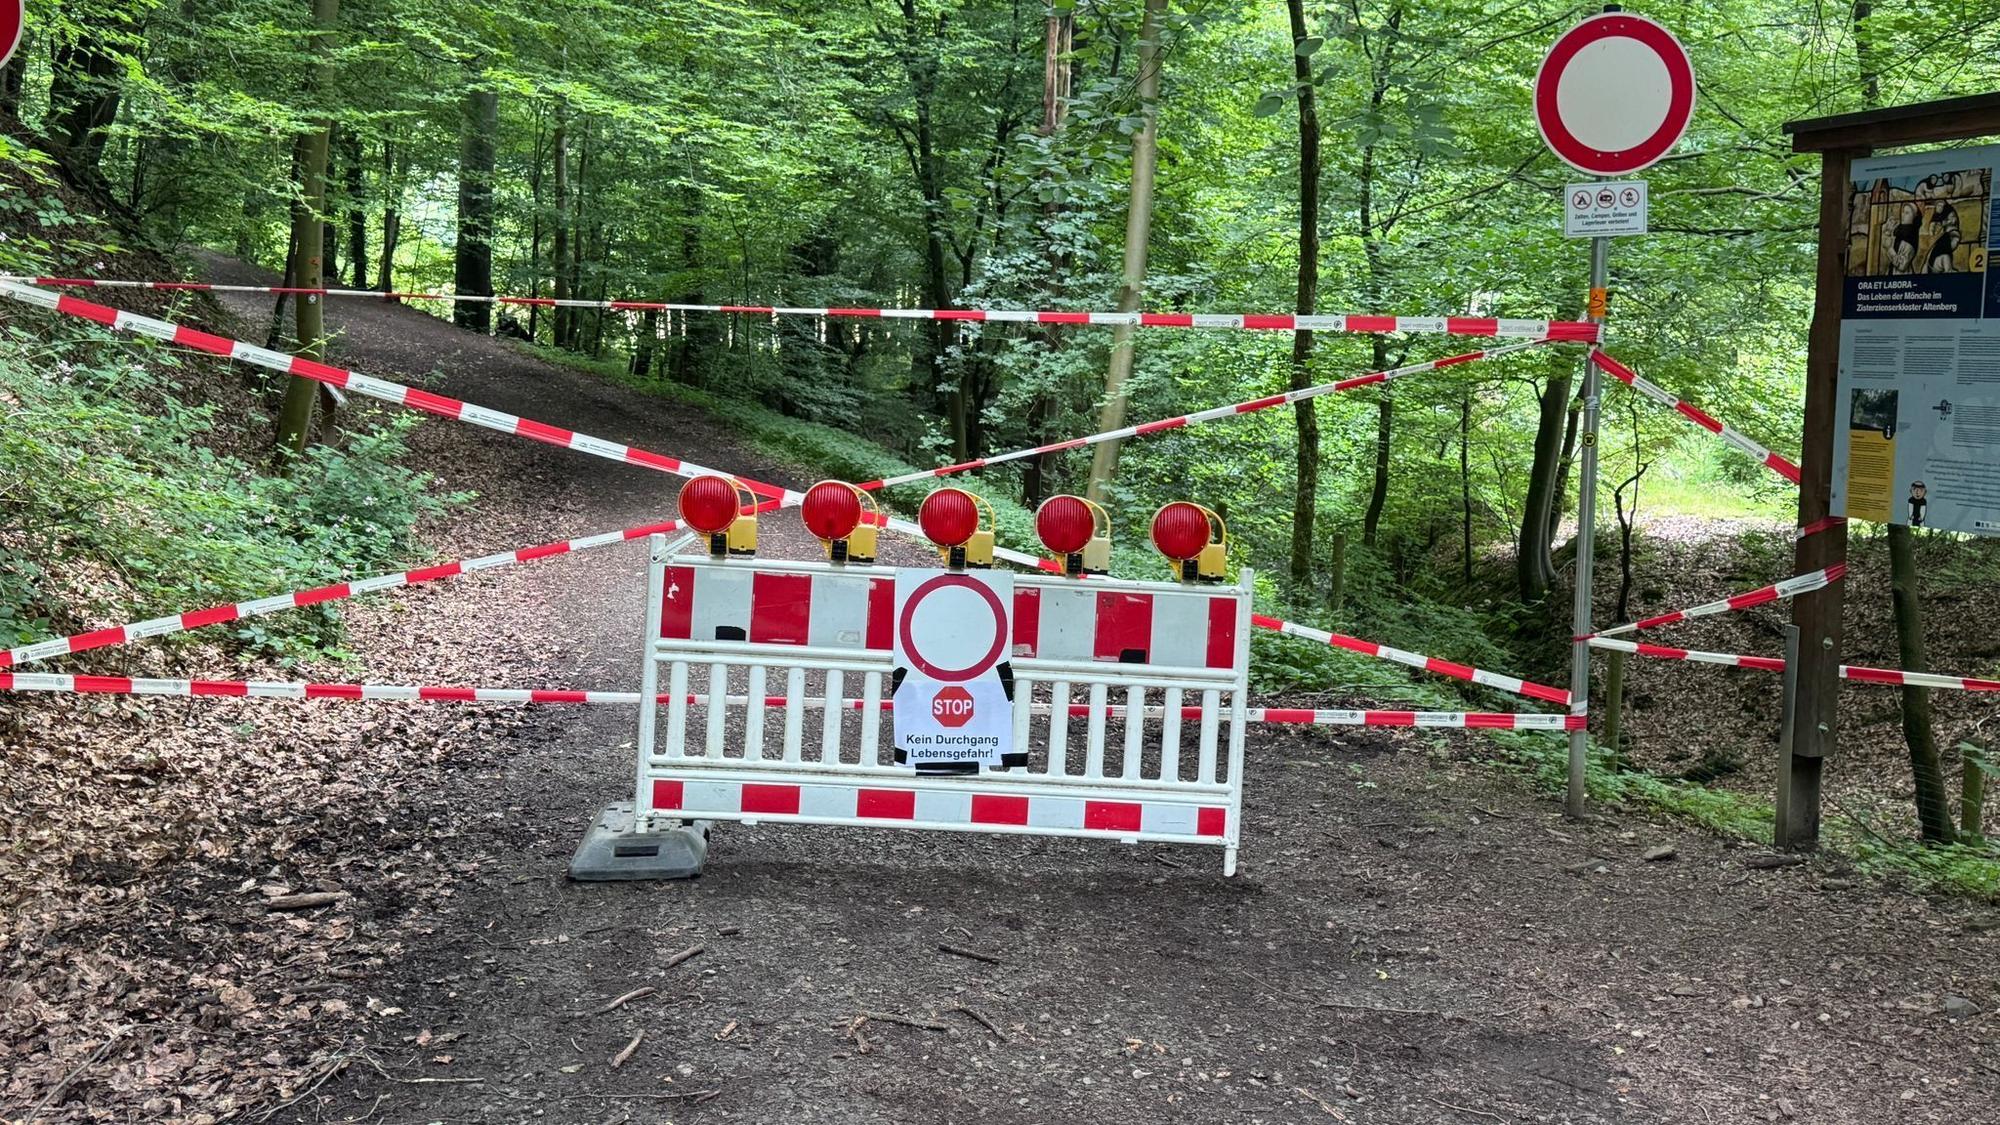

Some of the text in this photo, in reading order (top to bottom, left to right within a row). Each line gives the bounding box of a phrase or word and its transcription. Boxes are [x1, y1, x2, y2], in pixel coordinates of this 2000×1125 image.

[1974, 254, 1984, 268] 2
[1858, 282, 1872, 290] ORA
[1873, 281, 1882, 290] ET
[1883, 281, 1912, 289] LABORA
[1857, 291, 1942, 301] Das Leben der Mönche im
[1857, 302, 1958, 312] Zisterzienserkloster Altenberg
[933, 699, 973, 715] STOP
[906, 734, 999, 746] Kein Durchgang
[911, 748, 994, 760] Lebensgefahr!
